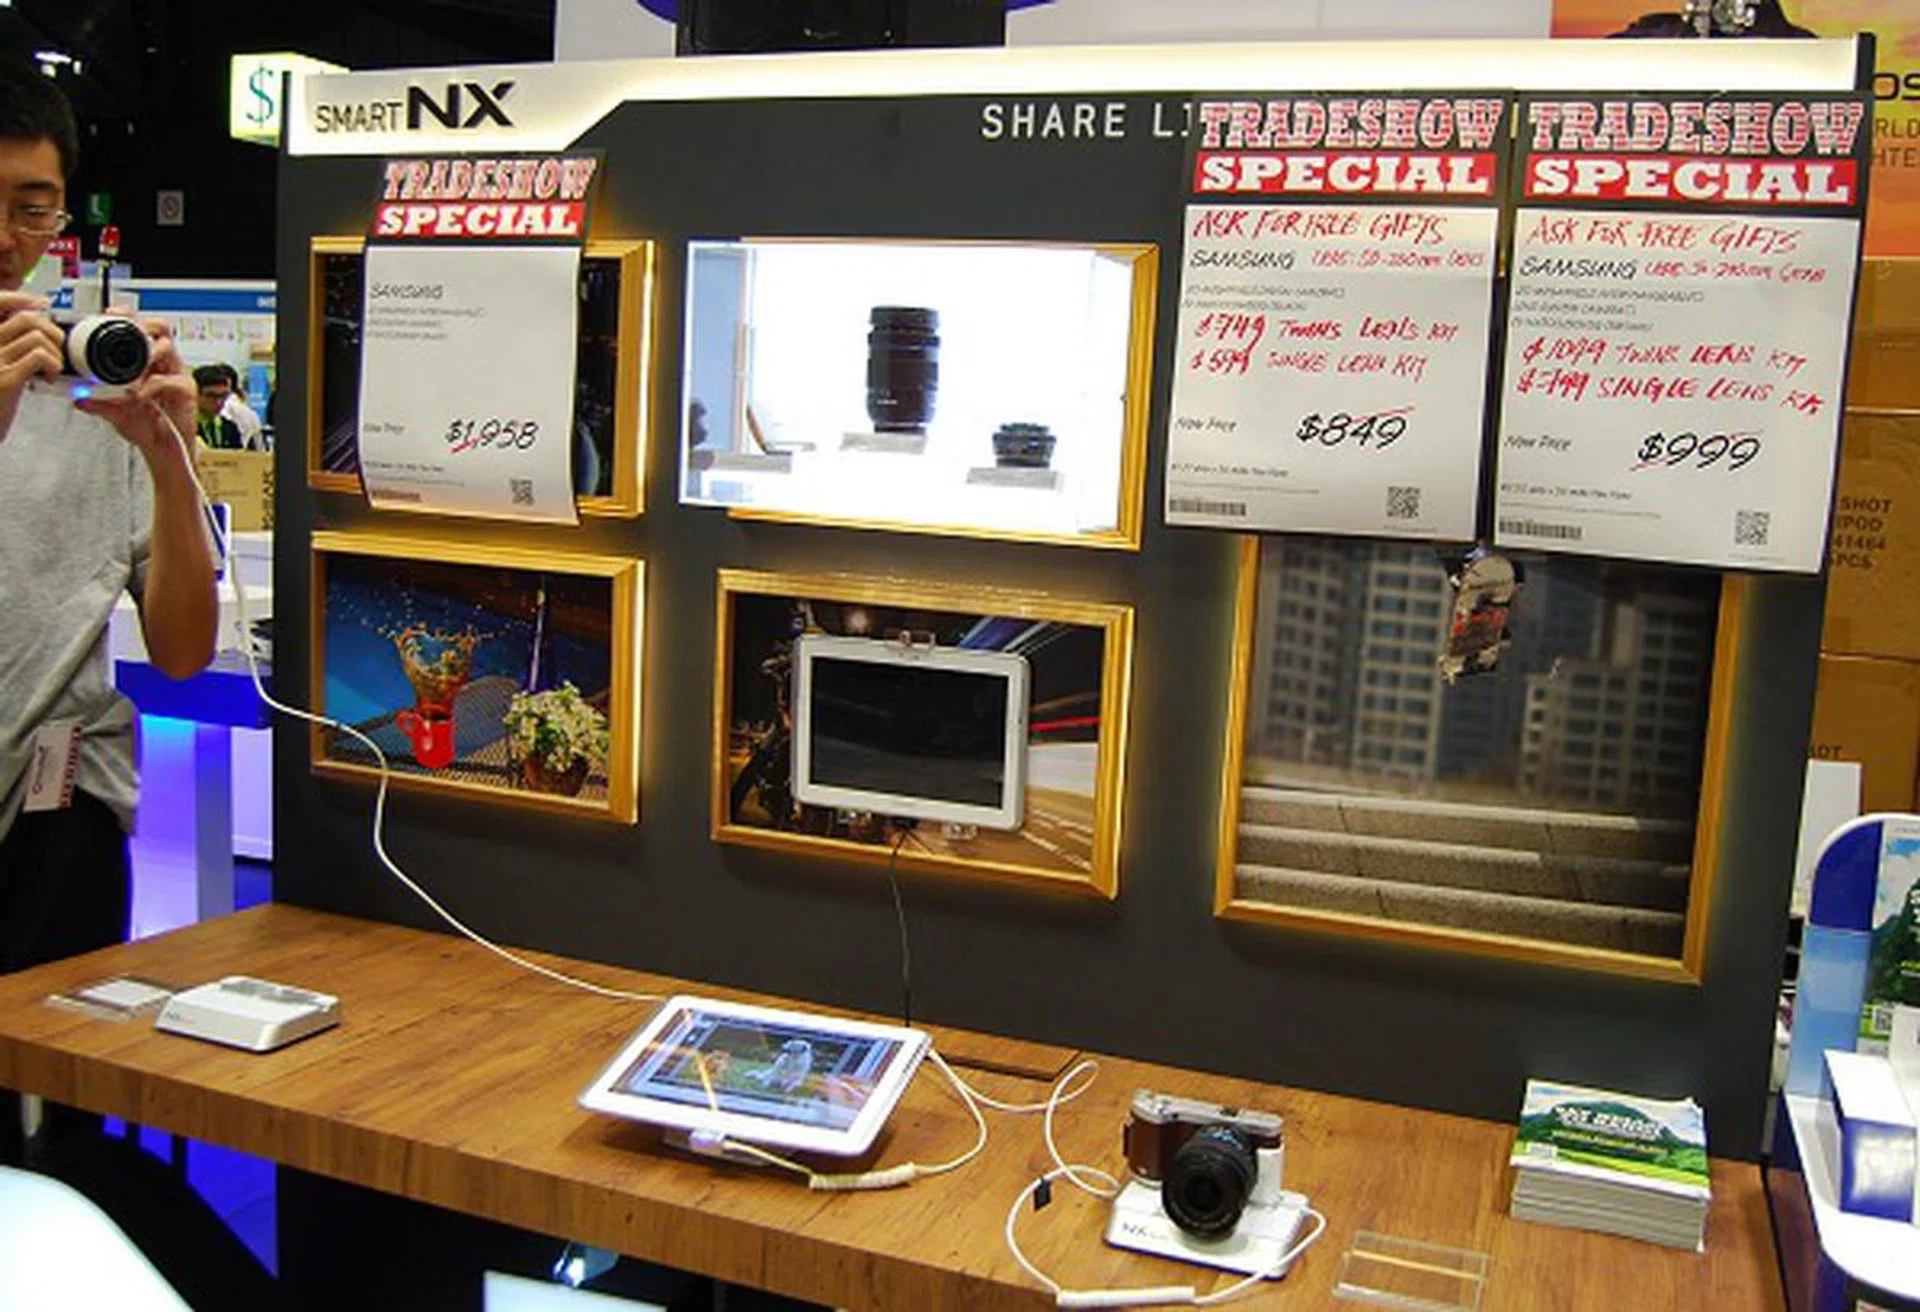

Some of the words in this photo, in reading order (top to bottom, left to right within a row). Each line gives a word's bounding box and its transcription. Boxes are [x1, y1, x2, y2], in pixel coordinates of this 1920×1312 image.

[245, 60, 275, 129] $
[315, 102, 403, 133] SMART
[407, 81, 516, 130] NX
[981, 102, 1127, 138] SHARE
[1200, 100, 1503, 149] TRADESHOW
[1528, 101, 1864, 154] TRADESHOW
[384, 157, 597, 200] TRADESHOW
[1200, 155, 1490, 192] SPECIAL
[1531, 158, 1849, 203] SPECIAL
[377, 203, 578, 236] SPECIAL
[1193, 210, 1249, 238] ASK
[1369, 211, 1448, 245] GIFTS
[1526, 215, 1580, 244] ASK
[1586, 219, 1632, 247] FOR
[1637, 221, 1699, 249] FREE
[1709, 220, 1802, 254] GIFTS
[1189, 249, 1295, 269] SAMSUNG
[1519, 255, 1637, 280] SAMSUNG
[1195, 313, 1266, 350] $749
[1597, 374, 1699, 404] SINGLE
[445, 418, 540, 452] $1,958
[1295, 410, 1409, 450] $849
[1637, 431, 1763, 471] $999
